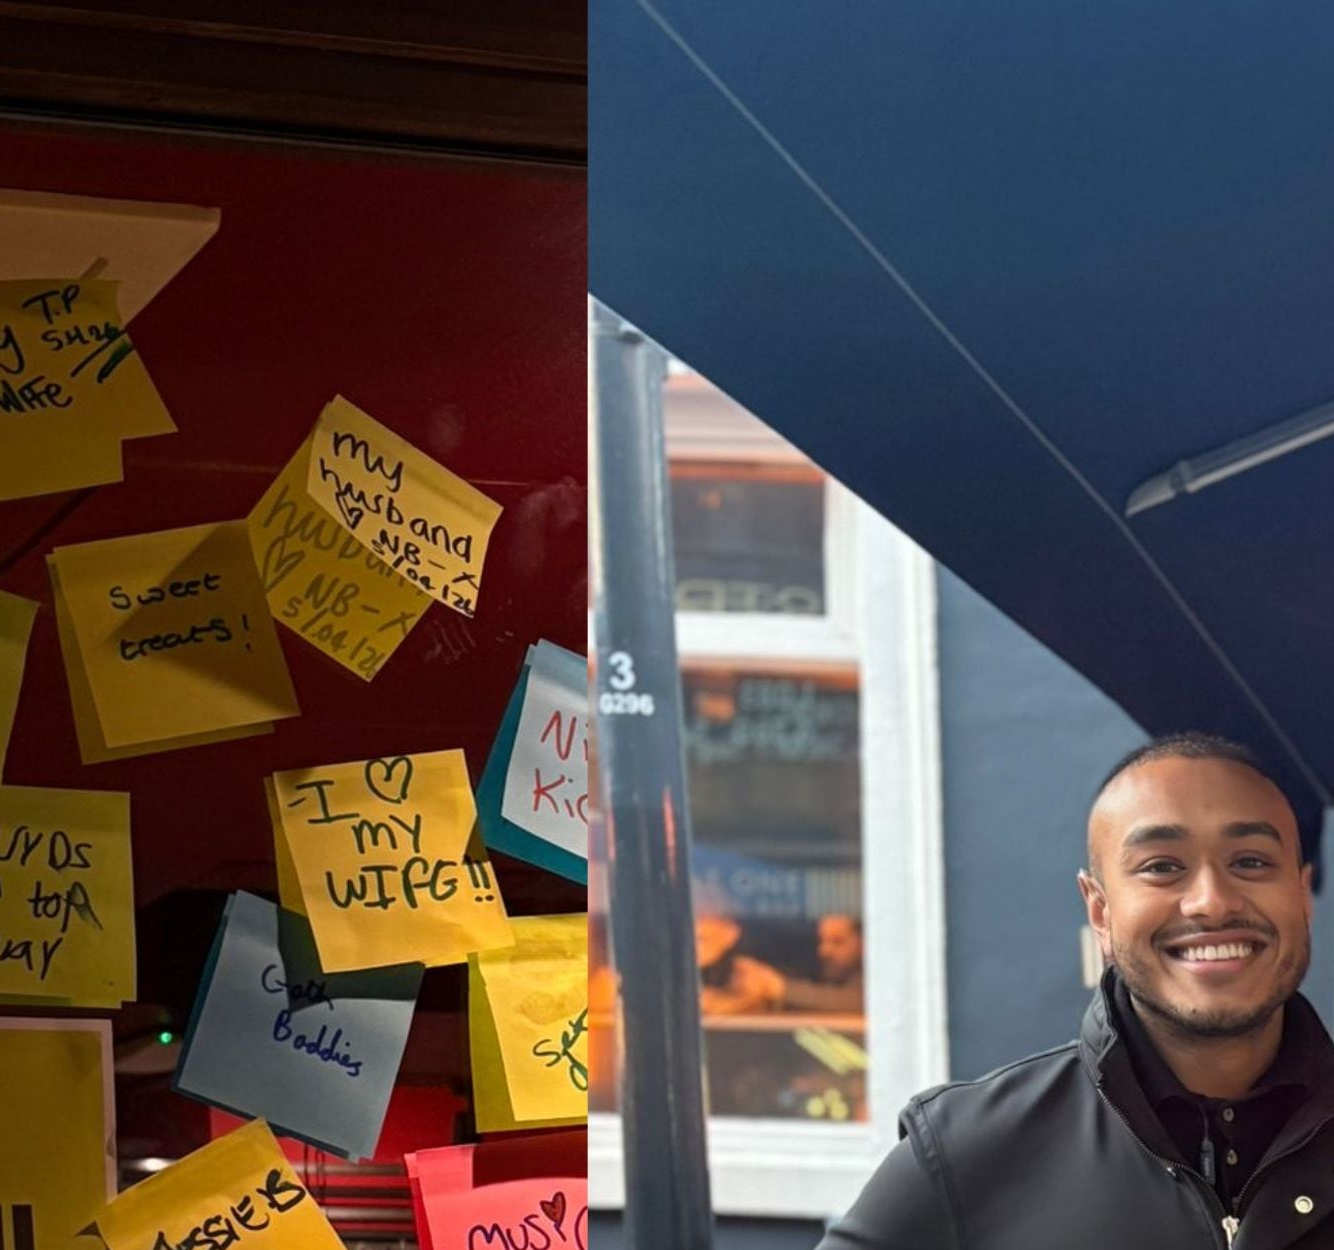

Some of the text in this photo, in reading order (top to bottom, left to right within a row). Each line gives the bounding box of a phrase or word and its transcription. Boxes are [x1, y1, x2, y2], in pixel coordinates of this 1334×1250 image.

[319, 456, 473, 564] husband
[110, 571, 222, 610] Sweet
[609, 651, 636, 690] 3
[272, 1010, 363, 1078] Baddies
